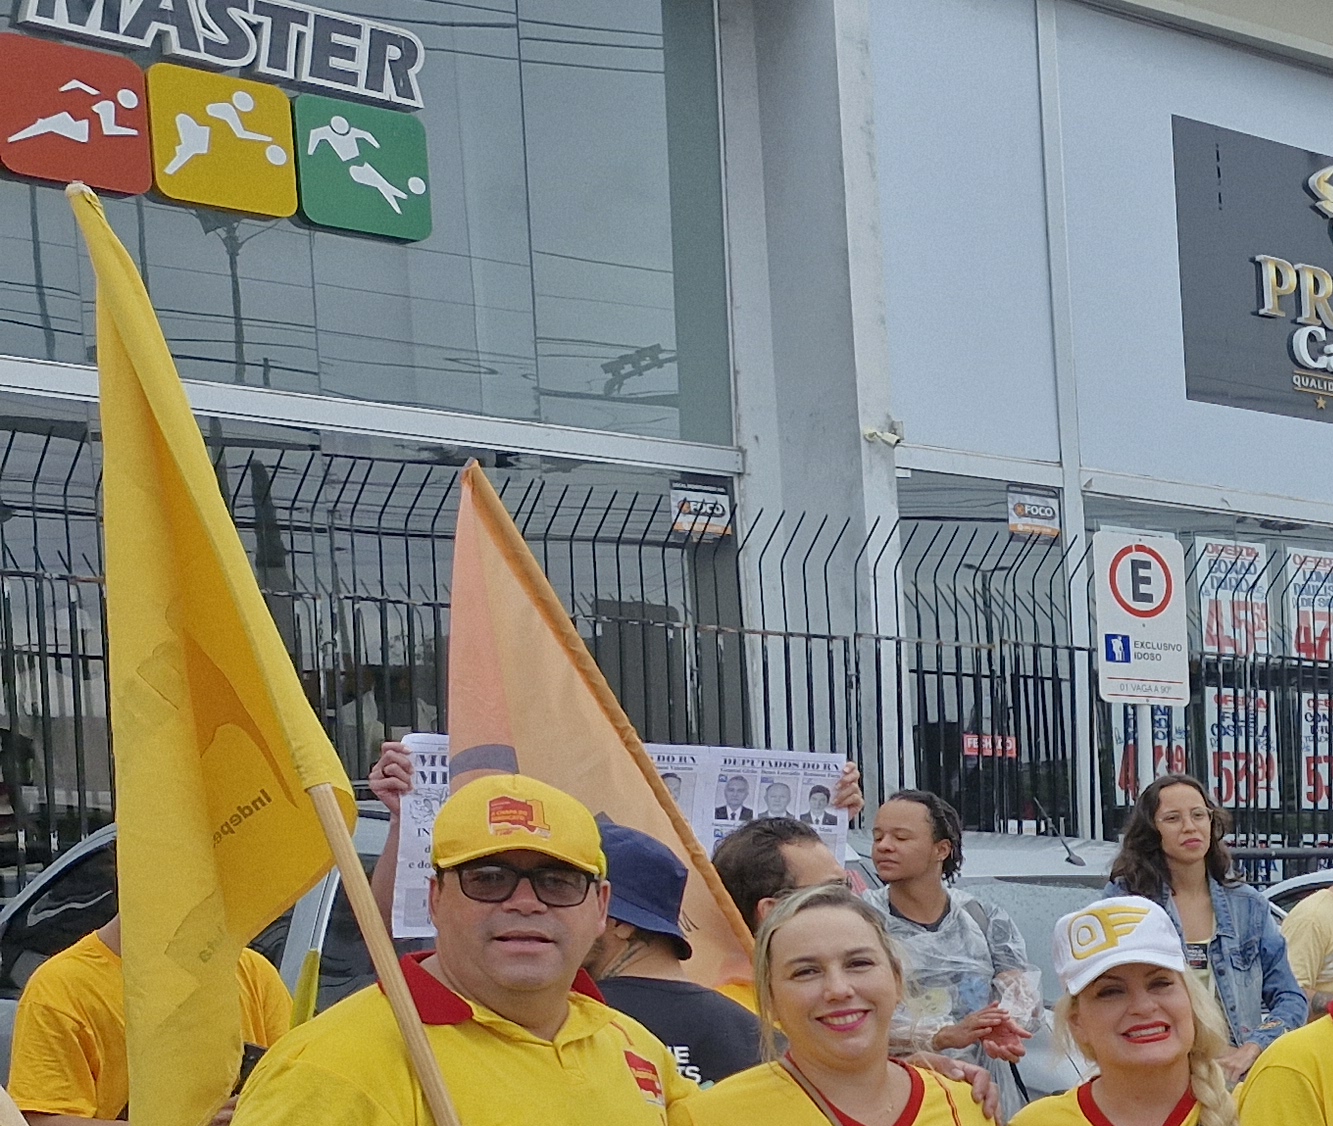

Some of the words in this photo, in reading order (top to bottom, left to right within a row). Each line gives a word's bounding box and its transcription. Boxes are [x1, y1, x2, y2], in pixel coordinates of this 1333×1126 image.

[1024, 505, 1053, 517] FOCO
[1131, 558, 1154, 604] E
[1133, 640, 1183, 652] EXCLUSIVO
[1133, 652, 1163, 662] IDOSO
[723, 757, 800, 769] DEPUTADOS
